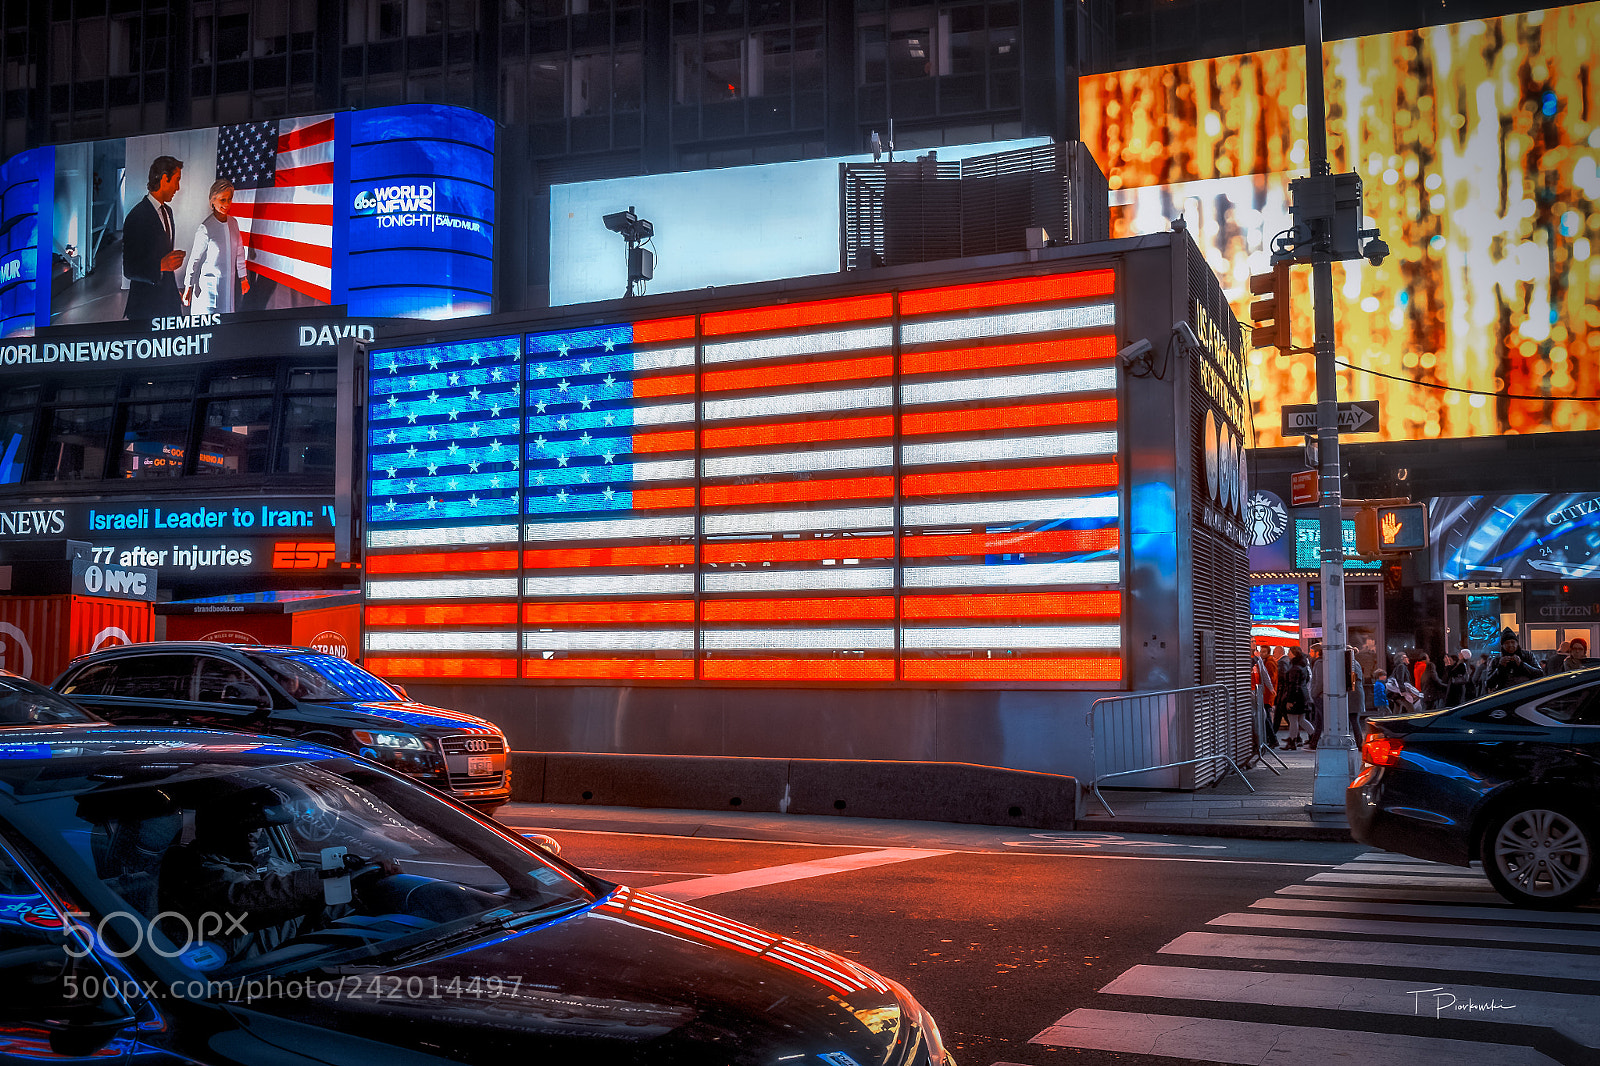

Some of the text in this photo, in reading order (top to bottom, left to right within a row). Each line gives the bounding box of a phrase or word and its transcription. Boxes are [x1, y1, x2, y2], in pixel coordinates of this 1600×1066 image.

[374, 185, 433, 201] WORLD
[355, 196, 376, 210] abc
[377, 198, 432, 213] NEWS
[376, 214, 432, 228] TONIGHT
[435, 216, 461, 228] DAVID
[151, 313, 221, 332] SIEMENS
[1337, 412, 1364, 424] WAY
[0, 509, 66, 535] NEWS
[89, 508, 149, 531] Israeli
[155, 506, 227, 529] Leader
[232, 507, 255, 528] to
[261, 505, 314, 528] Iran:
[91, 544, 252, 571] 77 after injuries
[1539, 546, 1553, 558] 24
[105, 569, 147, 595] NYC
[193, 605, 244, 613] strandbooks.com
[1539, 606, 1591, 616] CITIZEN
